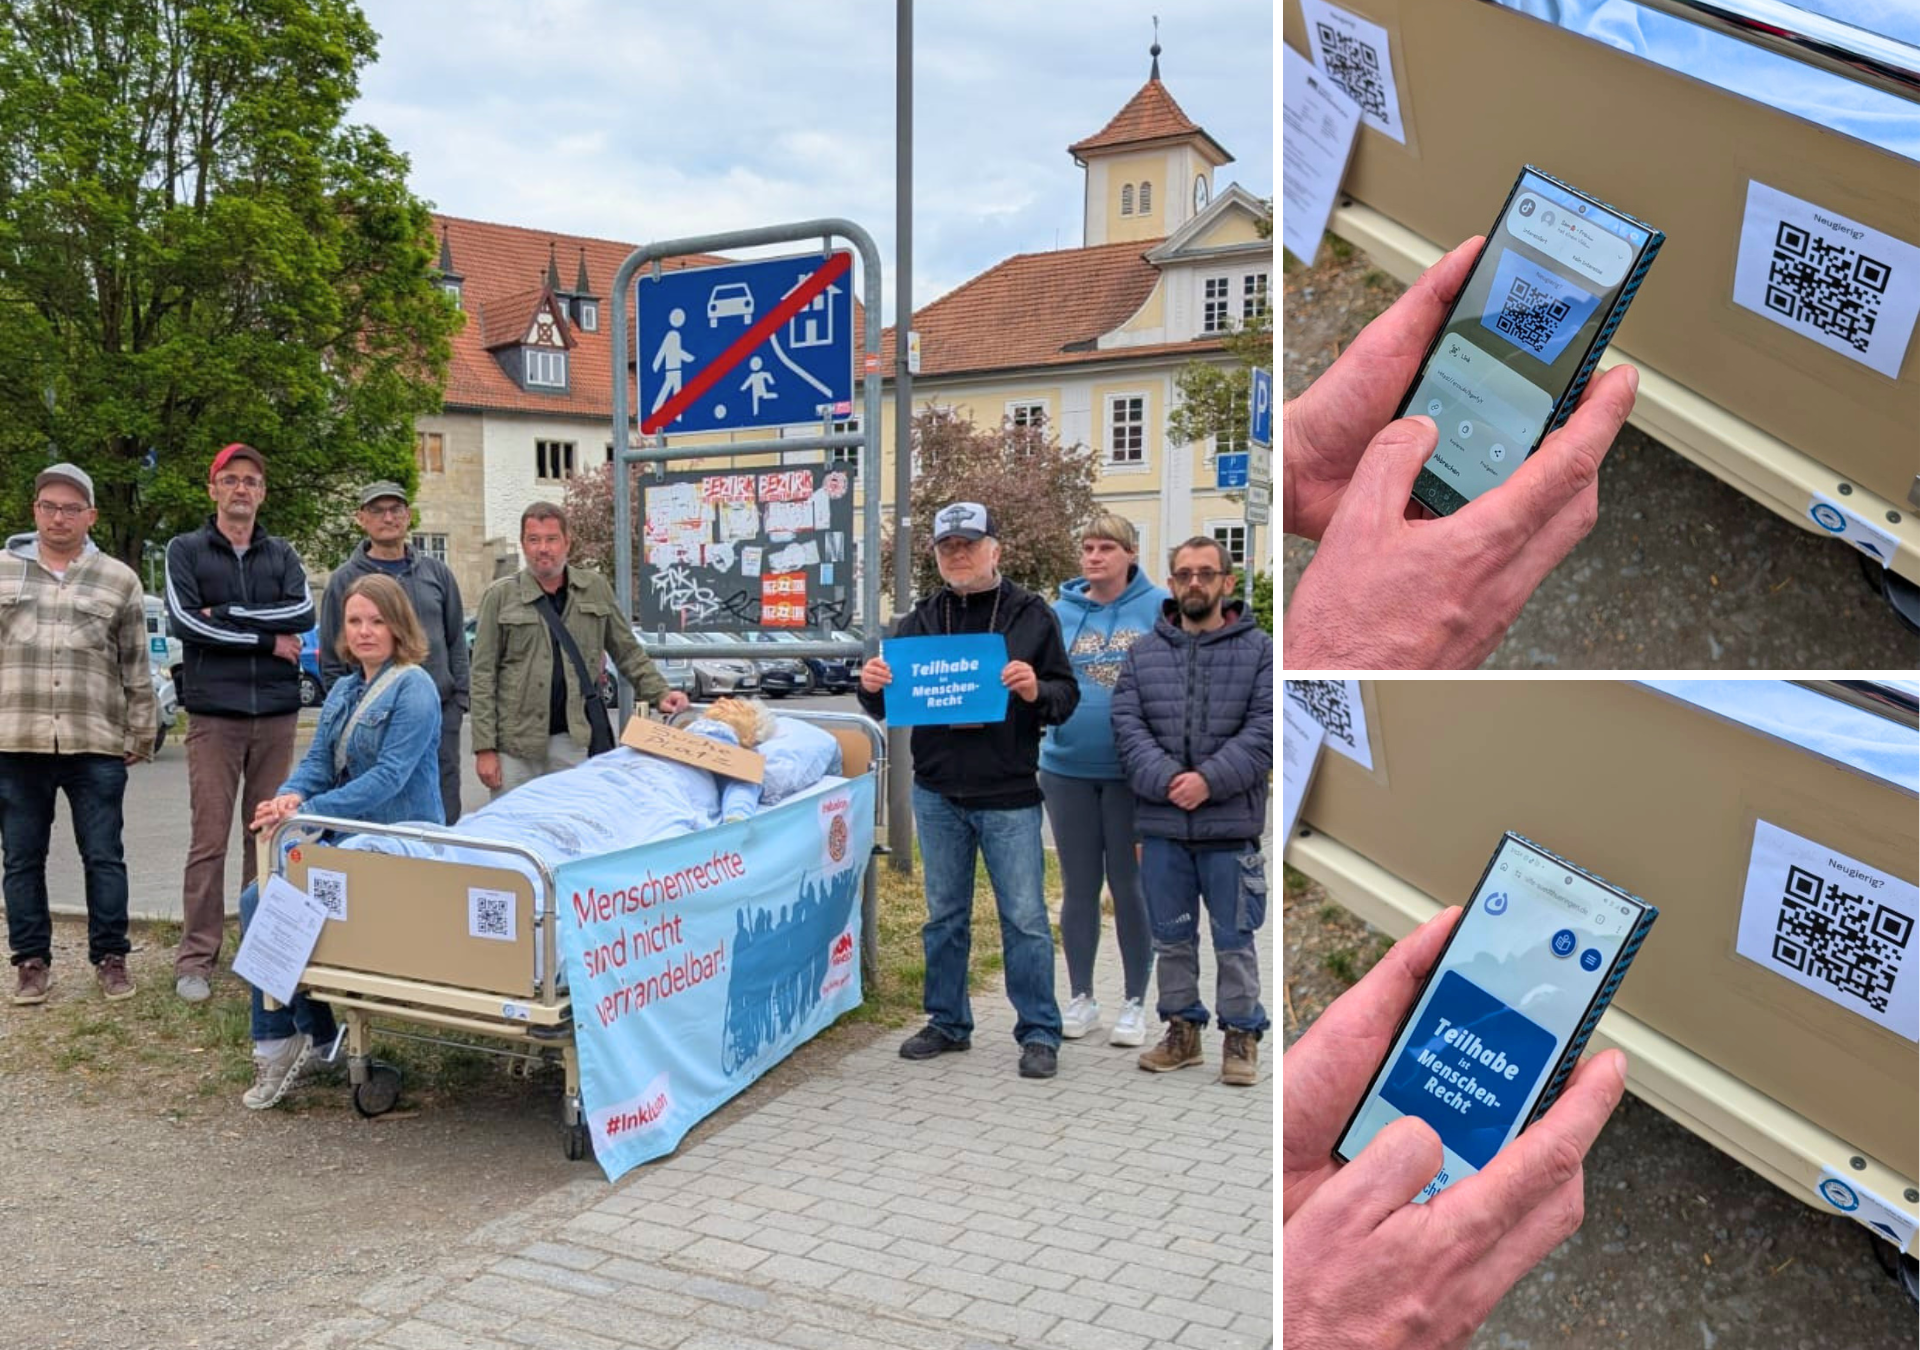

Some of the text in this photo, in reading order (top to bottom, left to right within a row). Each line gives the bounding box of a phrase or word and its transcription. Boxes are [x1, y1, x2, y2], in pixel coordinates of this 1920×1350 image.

[1813, 213, 1865, 240] Neugierig?
[1256, 380, 1268, 433] P
[1433, 453, 1460, 477] Abbrechen
[911, 657, 979, 677] Teilhabe
[912, 681, 980, 697] Menschen-
[927, 694, 963, 708] Recht
[1828, 858, 1885, 889] Neugierig?
[572, 851, 746, 930] Menschenrechte
[583, 912, 684, 979] sind nicht
[1433, 1017, 1520, 1080] Teilhabe
[1417, 1048, 1501, 1107] Menschen-
[1457, 1057, 1472, 1070] ist
[1423, 1075, 1472, 1115] Recht
[1434, 1168, 1449, 1185] in
